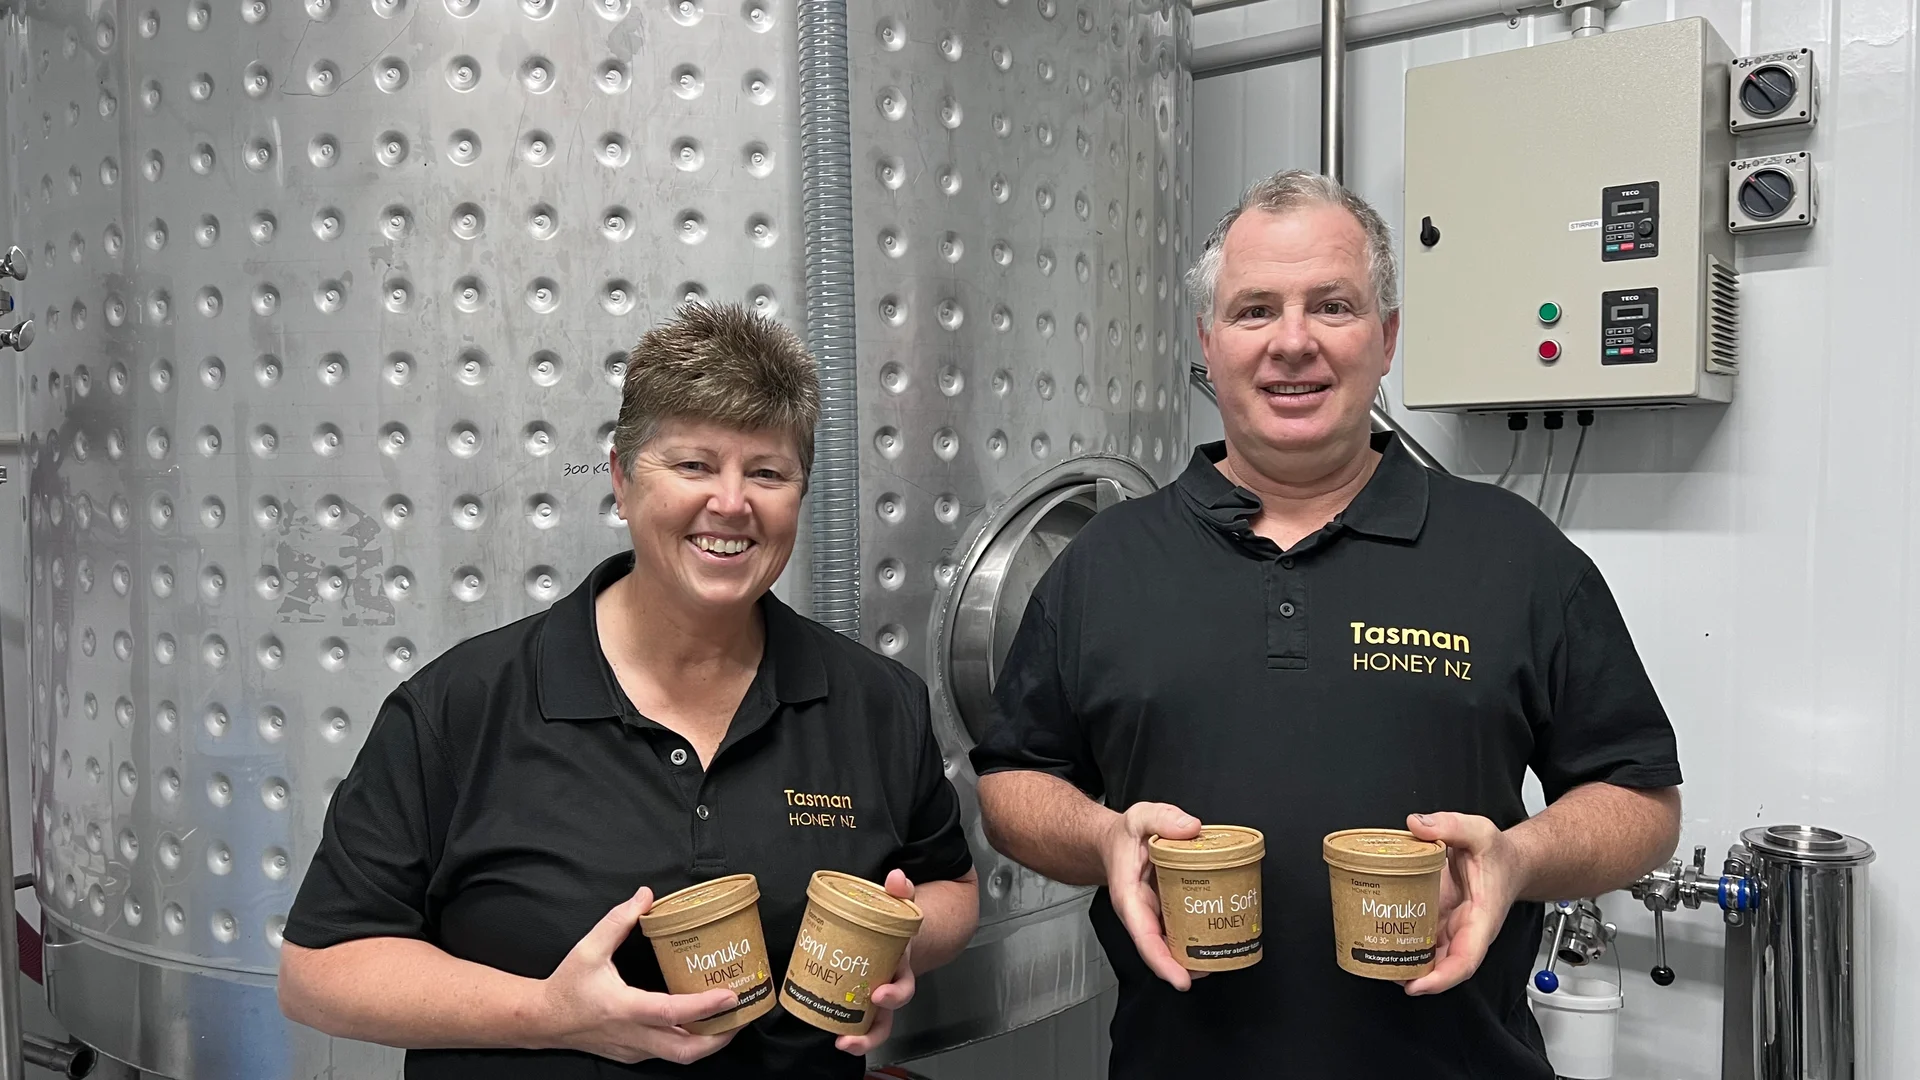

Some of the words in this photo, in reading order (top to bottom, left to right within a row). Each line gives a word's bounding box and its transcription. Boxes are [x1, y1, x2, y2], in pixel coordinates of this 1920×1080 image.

[1739, 60, 1753, 68] OFF
[1621, 189, 1640, 197] TECO
[1570, 220, 1599, 230] STIRRER
[564, 462, 589, 477] 300
[593, 462, 610, 475] KG
[1350, 621, 1470, 653] Tasman
[1353, 652, 1437, 674] HONEY
[1445, 658, 1472, 680] NZ
[783, 789, 853, 809] Tasman
[789, 812, 836, 827] HONEY
[840, 814, 857, 829] NZ
[1181, 877, 1210, 885] Tasman
[1351, 878, 1380, 889] Tasman
[1184, 896, 1224, 914] Semi
[1230, 887, 1258, 912] Soft
[1362, 897, 1427, 919] Manuka
[808, 908, 825, 926] Tasman
[1208, 913, 1246, 930] HONEY
[1375, 921, 1417, 935] HONEY
[670, 935, 699, 948] Tasman
[1364, 935, 1378, 944] MGO
[673, 945, 693, 954] HONEY
[685, 938, 752, 974] Manuka
[798, 928, 828, 961] Semi
[829, 949, 870, 977] Soft
[1199, 949, 1224, 958] Packaged
[1237, 946, 1250, 954] better
[1364, 953, 1390, 963] Packaged
[704, 960, 745, 987] HONEY
[804, 958, 844, 986] HONEY
[740, 993, 756, 1005] better
[805, 997, 814, 1005] for
[816, 1003, 835, 1014] better
[834, 1009, 851, 1019] future
